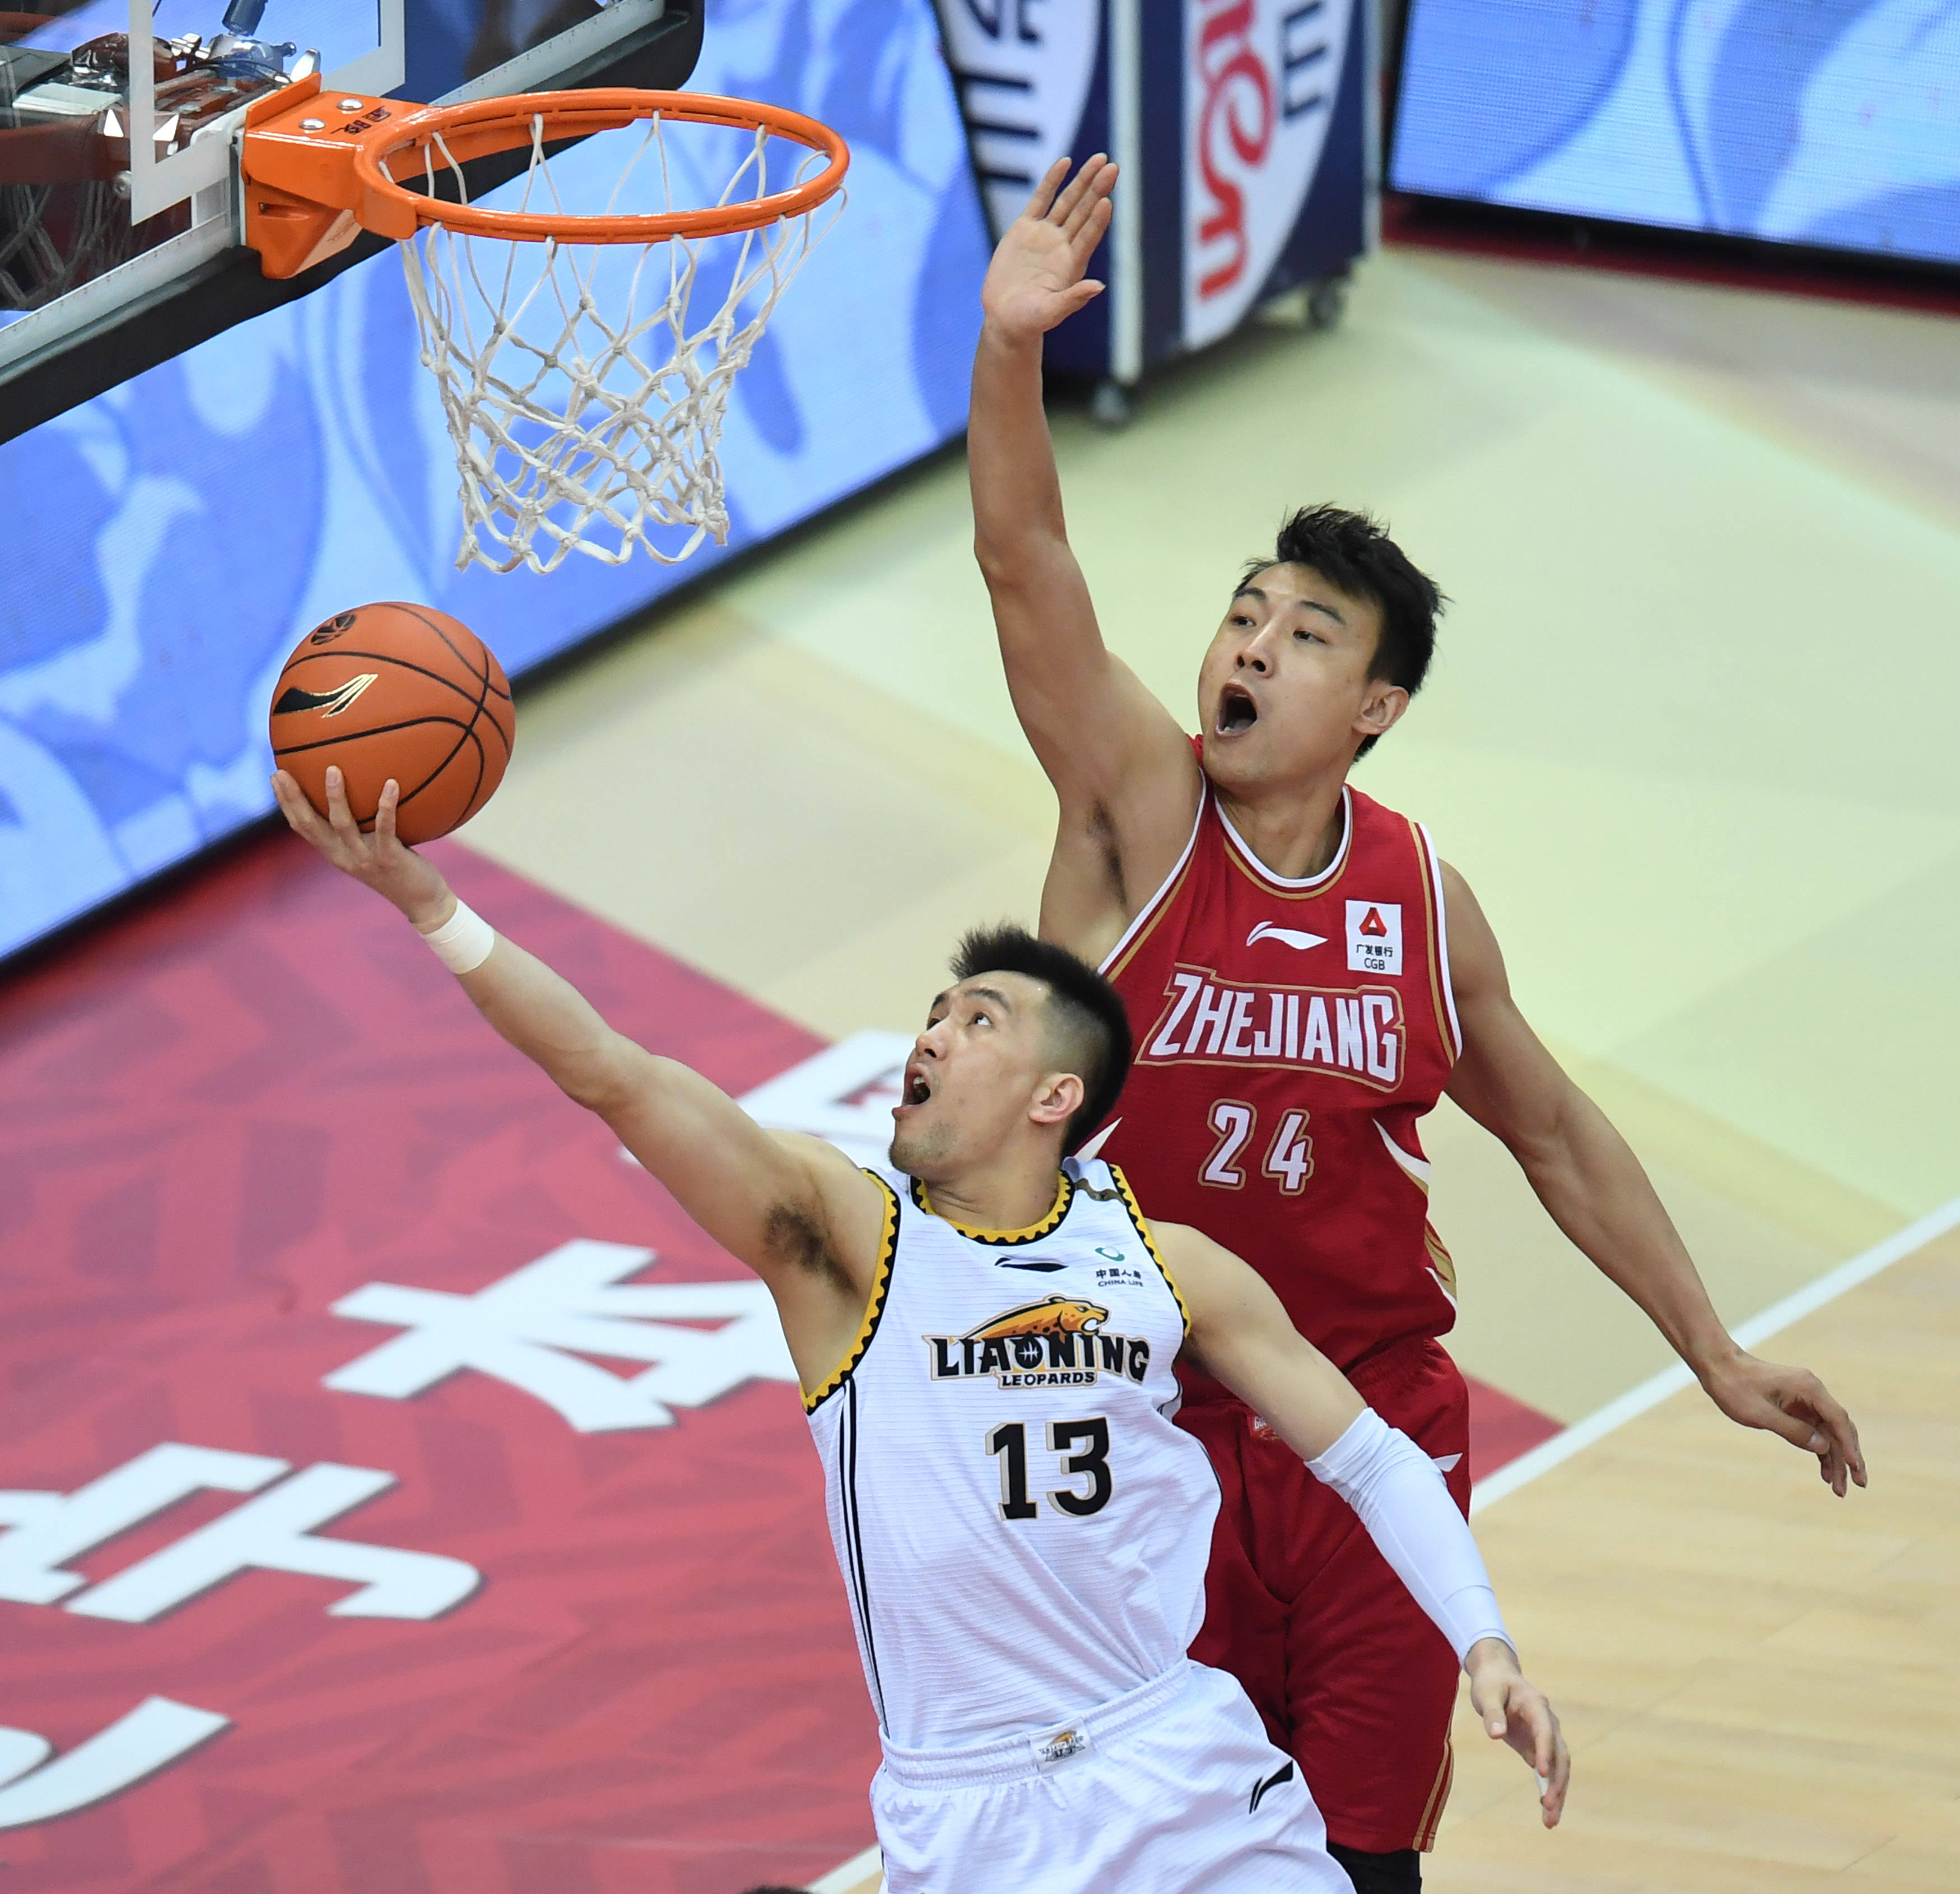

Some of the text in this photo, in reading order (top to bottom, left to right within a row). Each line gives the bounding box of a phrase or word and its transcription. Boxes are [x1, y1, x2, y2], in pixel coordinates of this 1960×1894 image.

[1356, 943, 1394, 958] 广发银行
[1363, 957, 1386, 971] CGB
[1148, 972, 1399, 1083] ZHEJIANG
[1202, 1102, 1310, 1192] 24
[1097, 1279, 1126, 1287] CHINA
[925, 1333, 1151, 1384] LIAONING
[1000, 1371, 1096, 1387] LEOPARDS
[986, 1417, 1113, 1520] 13
